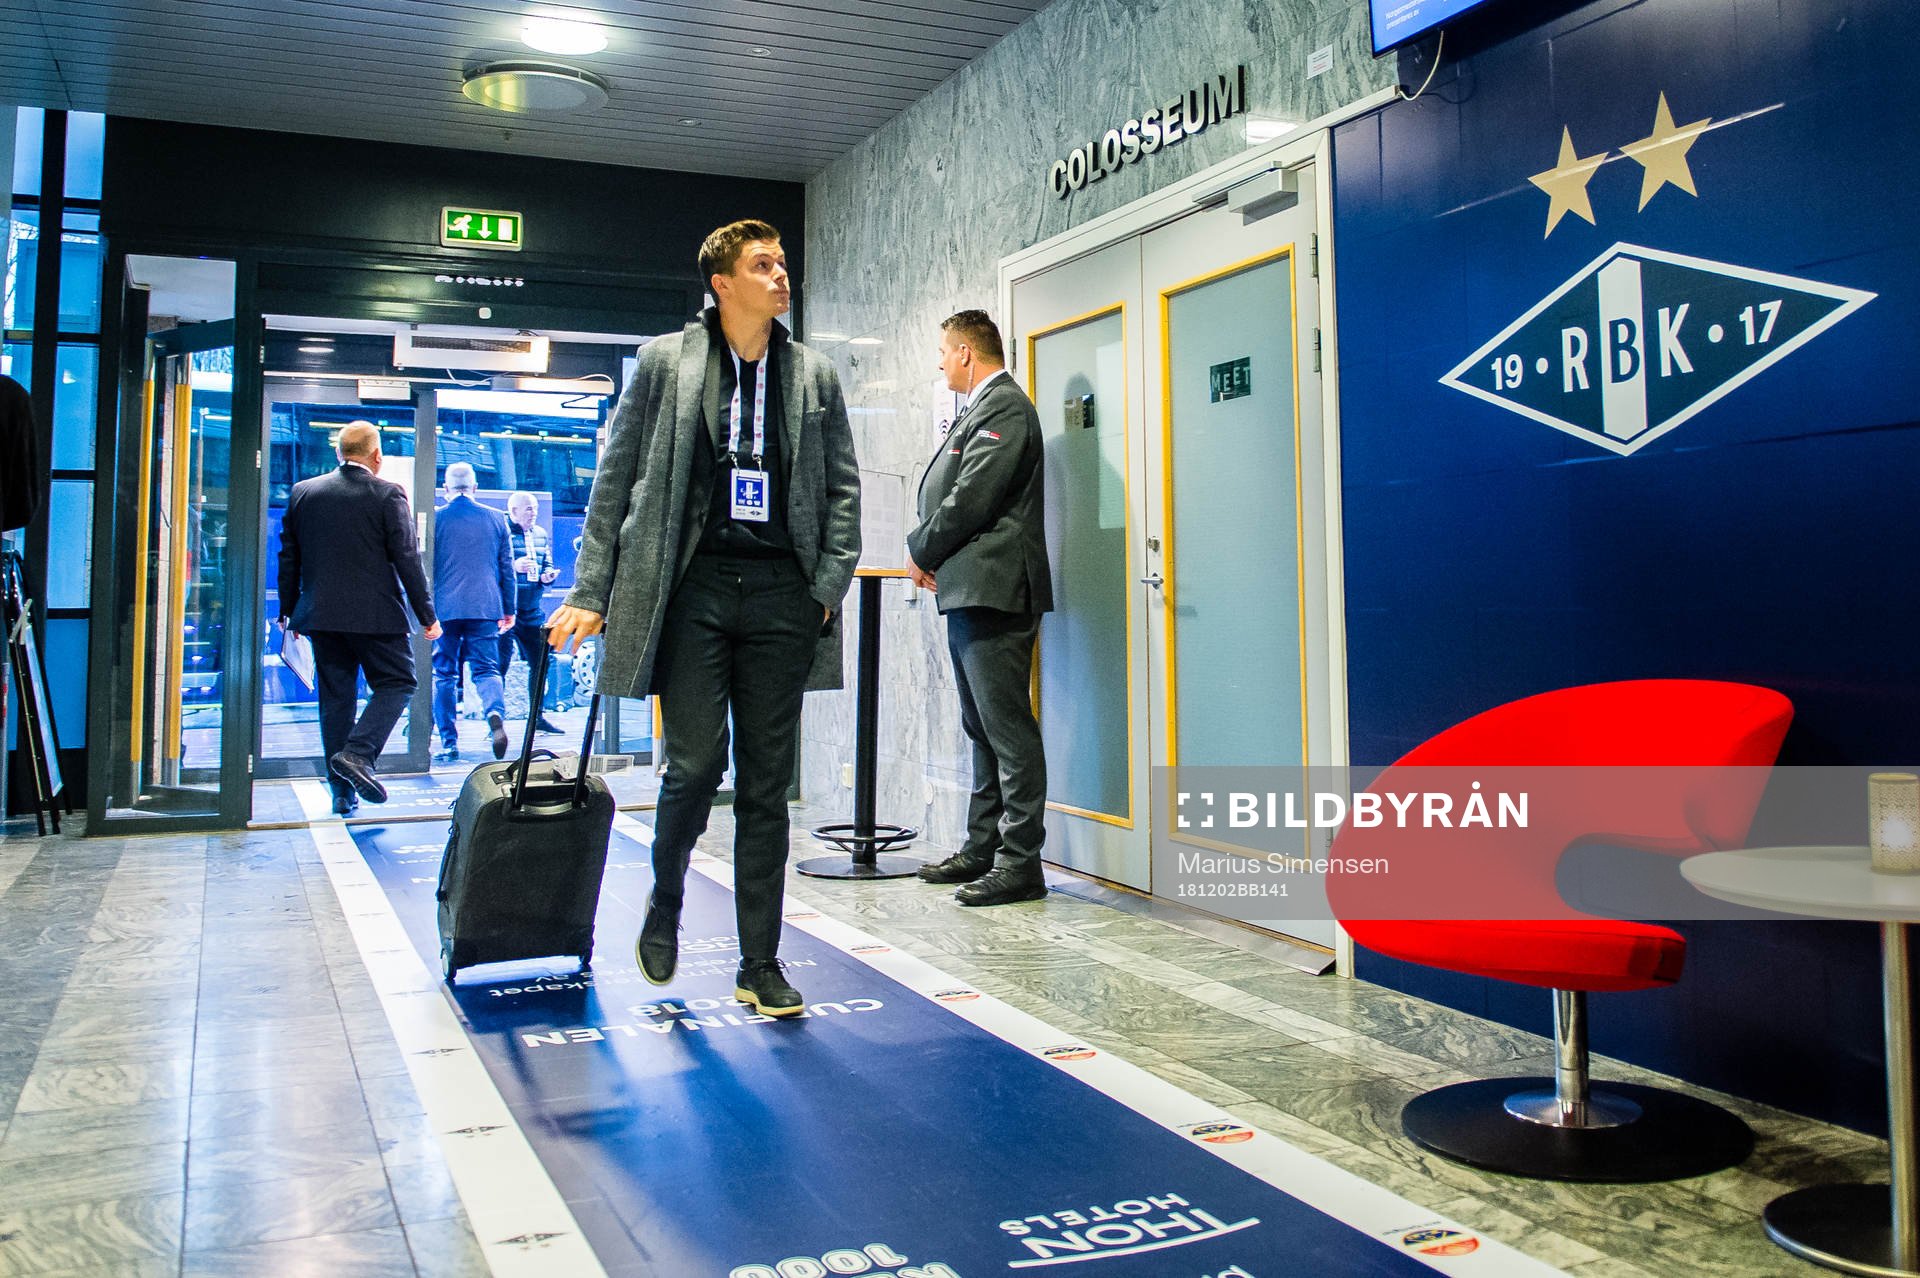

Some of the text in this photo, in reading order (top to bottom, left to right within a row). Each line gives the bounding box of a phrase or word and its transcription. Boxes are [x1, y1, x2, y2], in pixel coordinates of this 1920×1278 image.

[1050, 65, 1245, 200] COLOSSEUM
[1491, 300, 1783, 393] 19 RBK 17
[1211, 366, 1250, 393] MEET
[522, 998, 884, 1047] CUFINALEN
[999, 1192, 1189, 1235] HOTELS
[1008, 1208, 1260, 1269] THON
